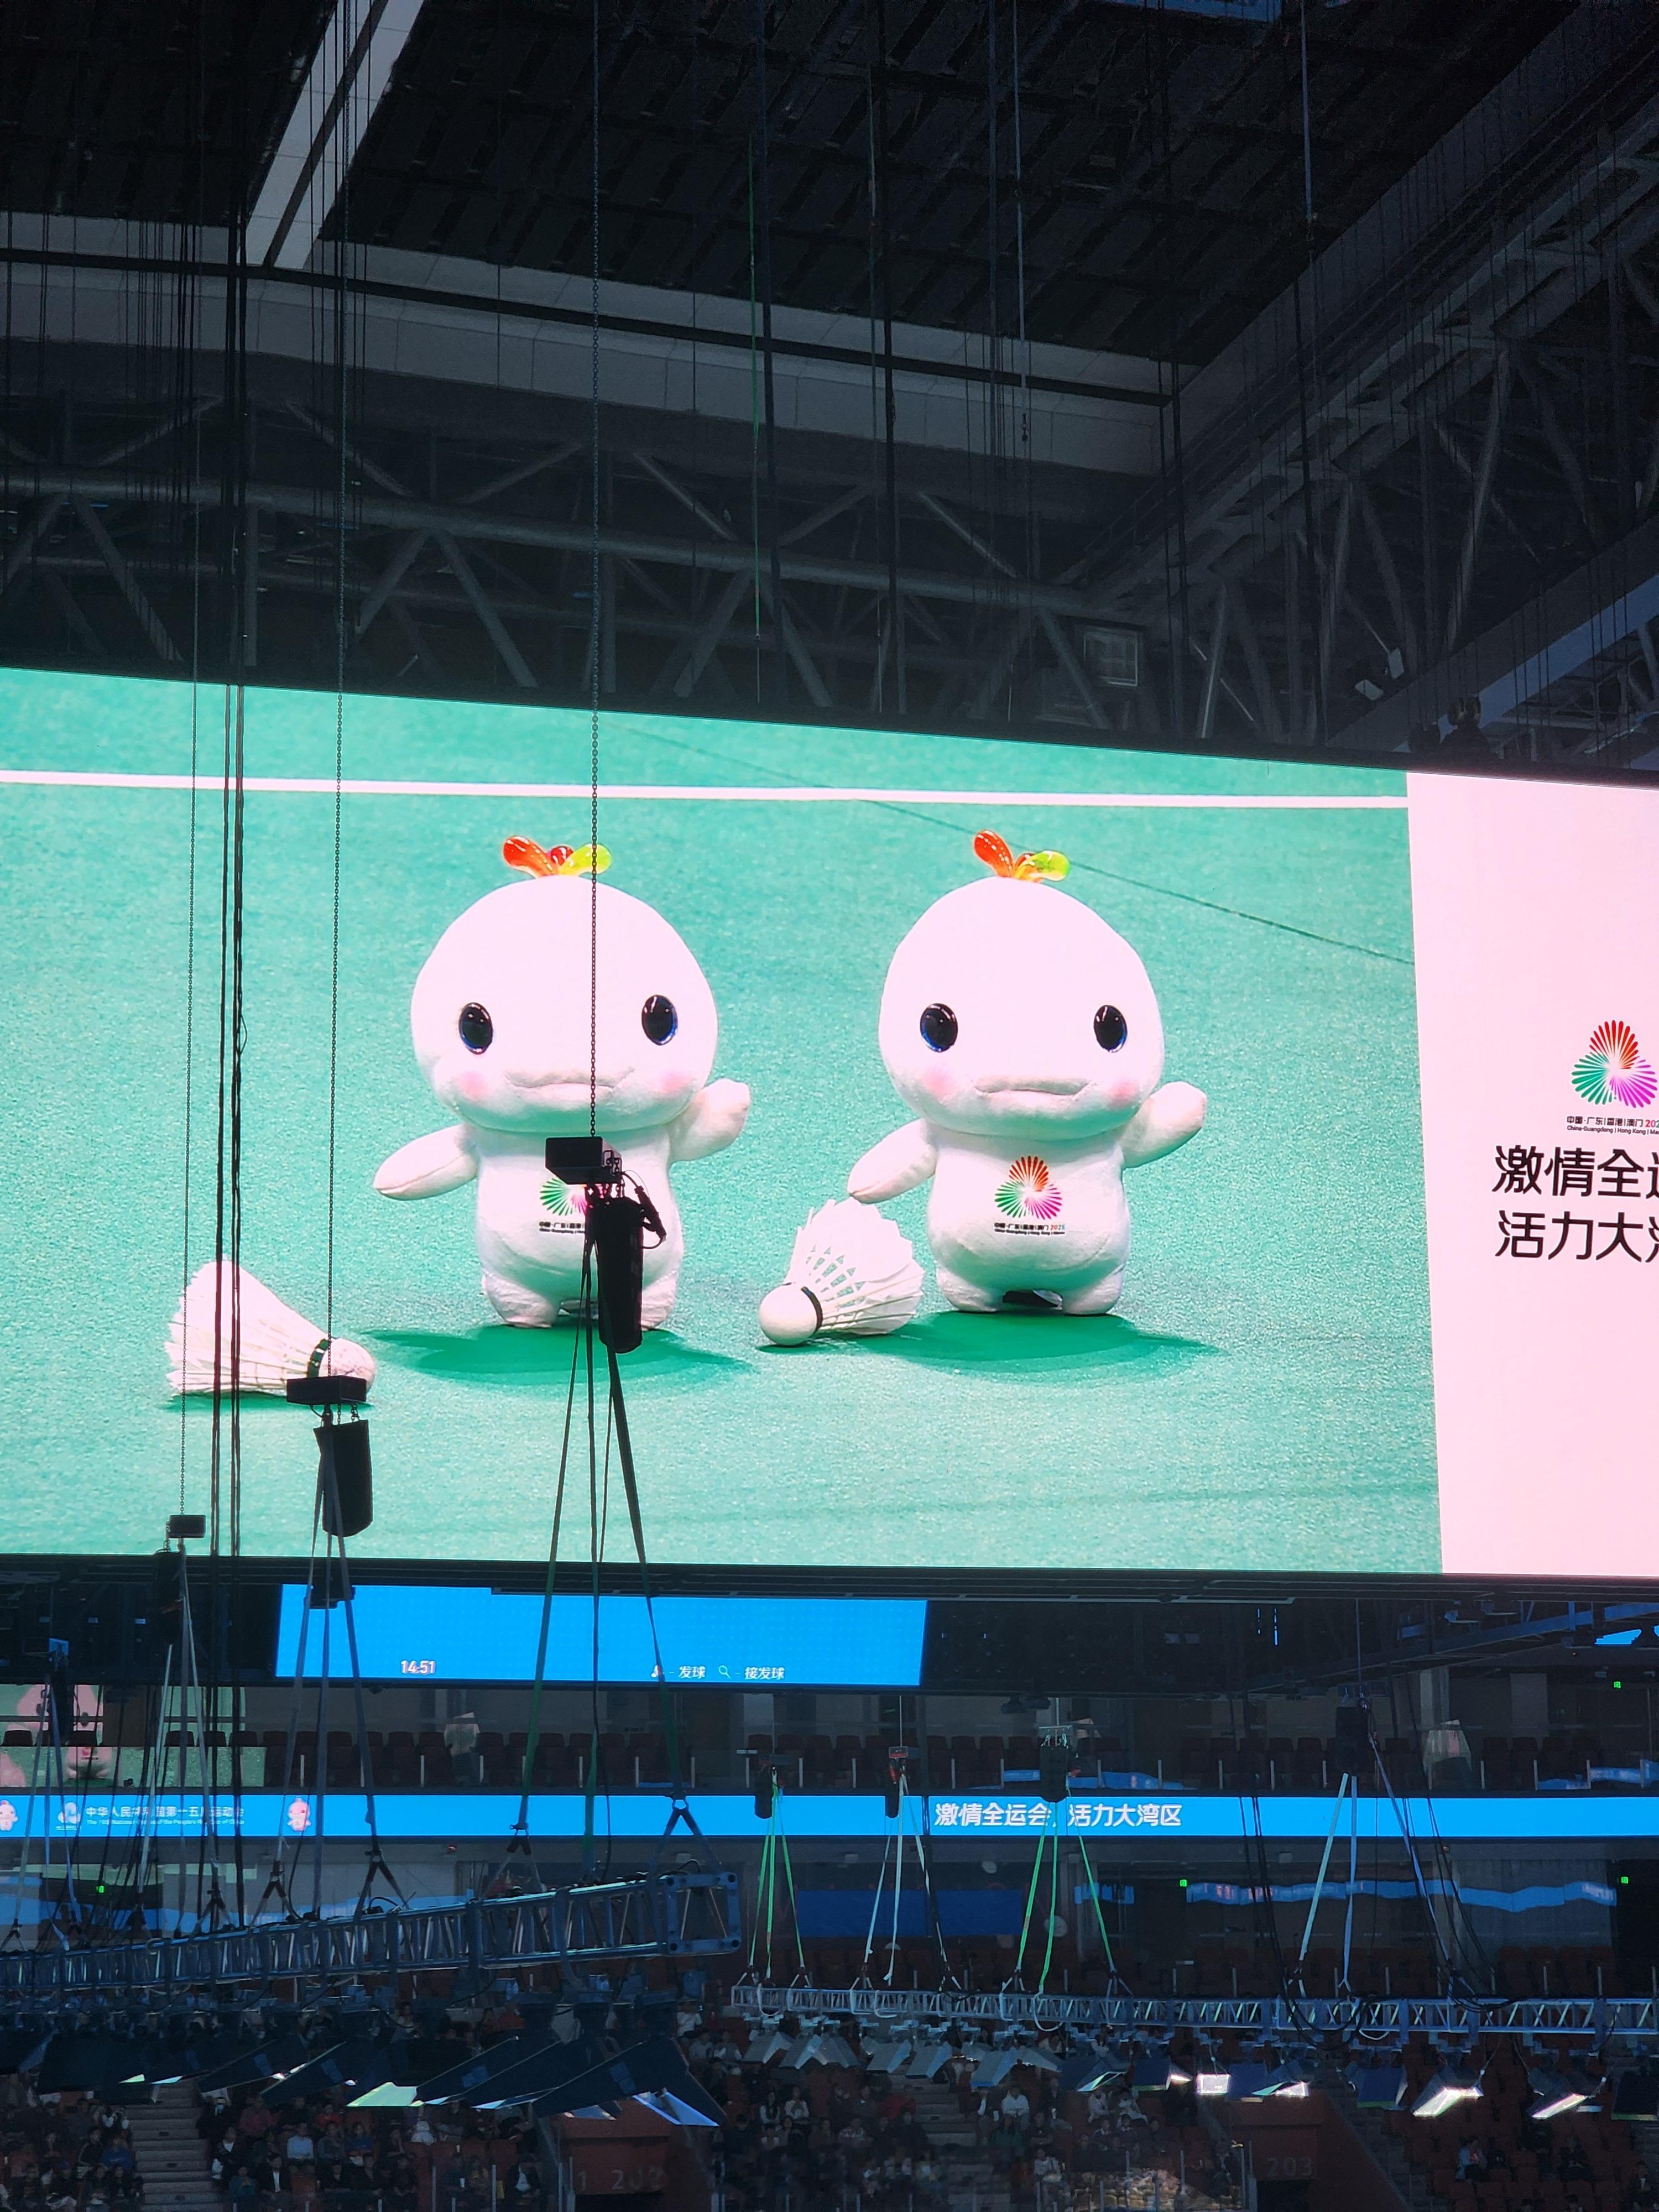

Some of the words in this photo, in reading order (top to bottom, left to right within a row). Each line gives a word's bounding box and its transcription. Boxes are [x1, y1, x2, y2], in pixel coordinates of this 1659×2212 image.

[401, 1660, 436, 1674] 14:51
[679, 1666, 706, 1679] 发球
[745, 1666, 785, 1680] 接发球
